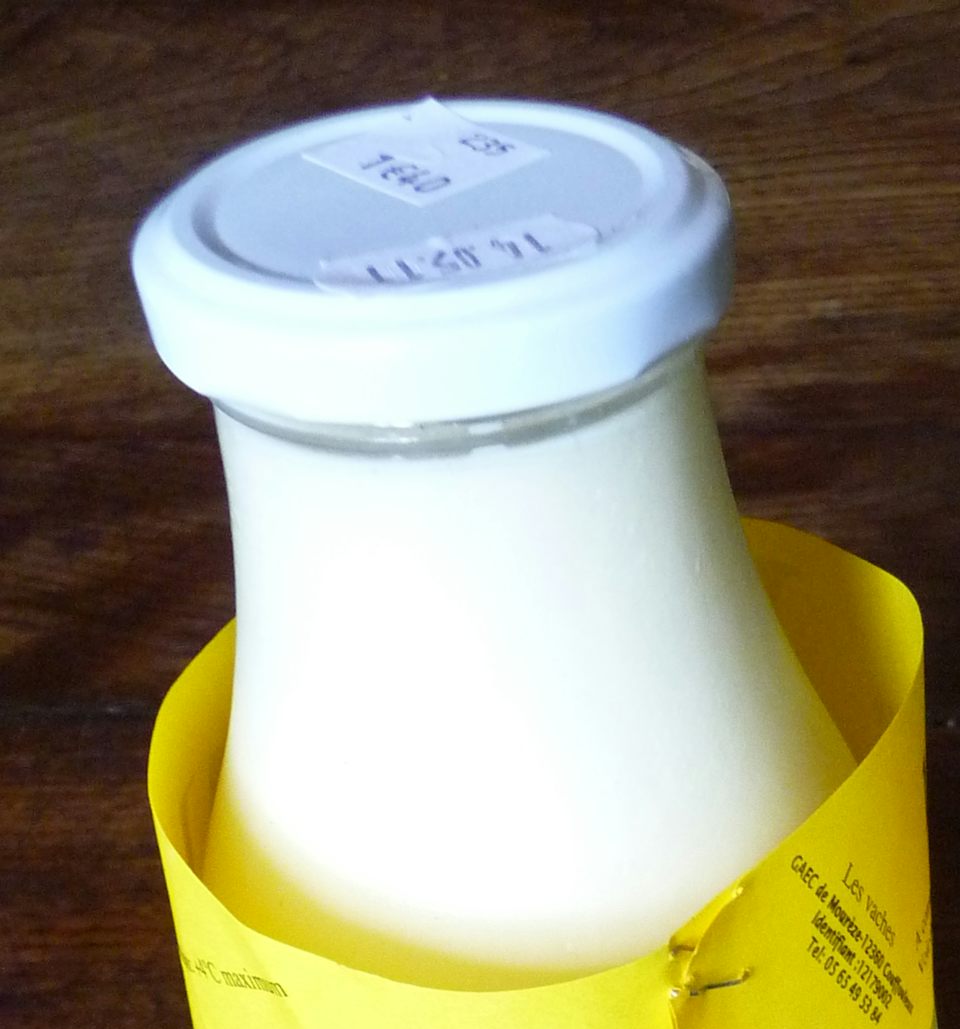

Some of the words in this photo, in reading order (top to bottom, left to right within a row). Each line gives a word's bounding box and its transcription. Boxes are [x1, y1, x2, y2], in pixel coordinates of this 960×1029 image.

[790, 854, 820, 890] GAEC
[815, 882, 828, 903] de
[841, 861, 865, 903] Les
[865, 895, 897, 948] vaches
[811, 909, 857, 967] Identifiant
[220, 967, 289, 998] maximum
[823, 955, 840, 977] 05
[836, 968, 851, 990] 65
[849, 981, 863, 1003] 49
[858, 993, 874, 1015] 53
